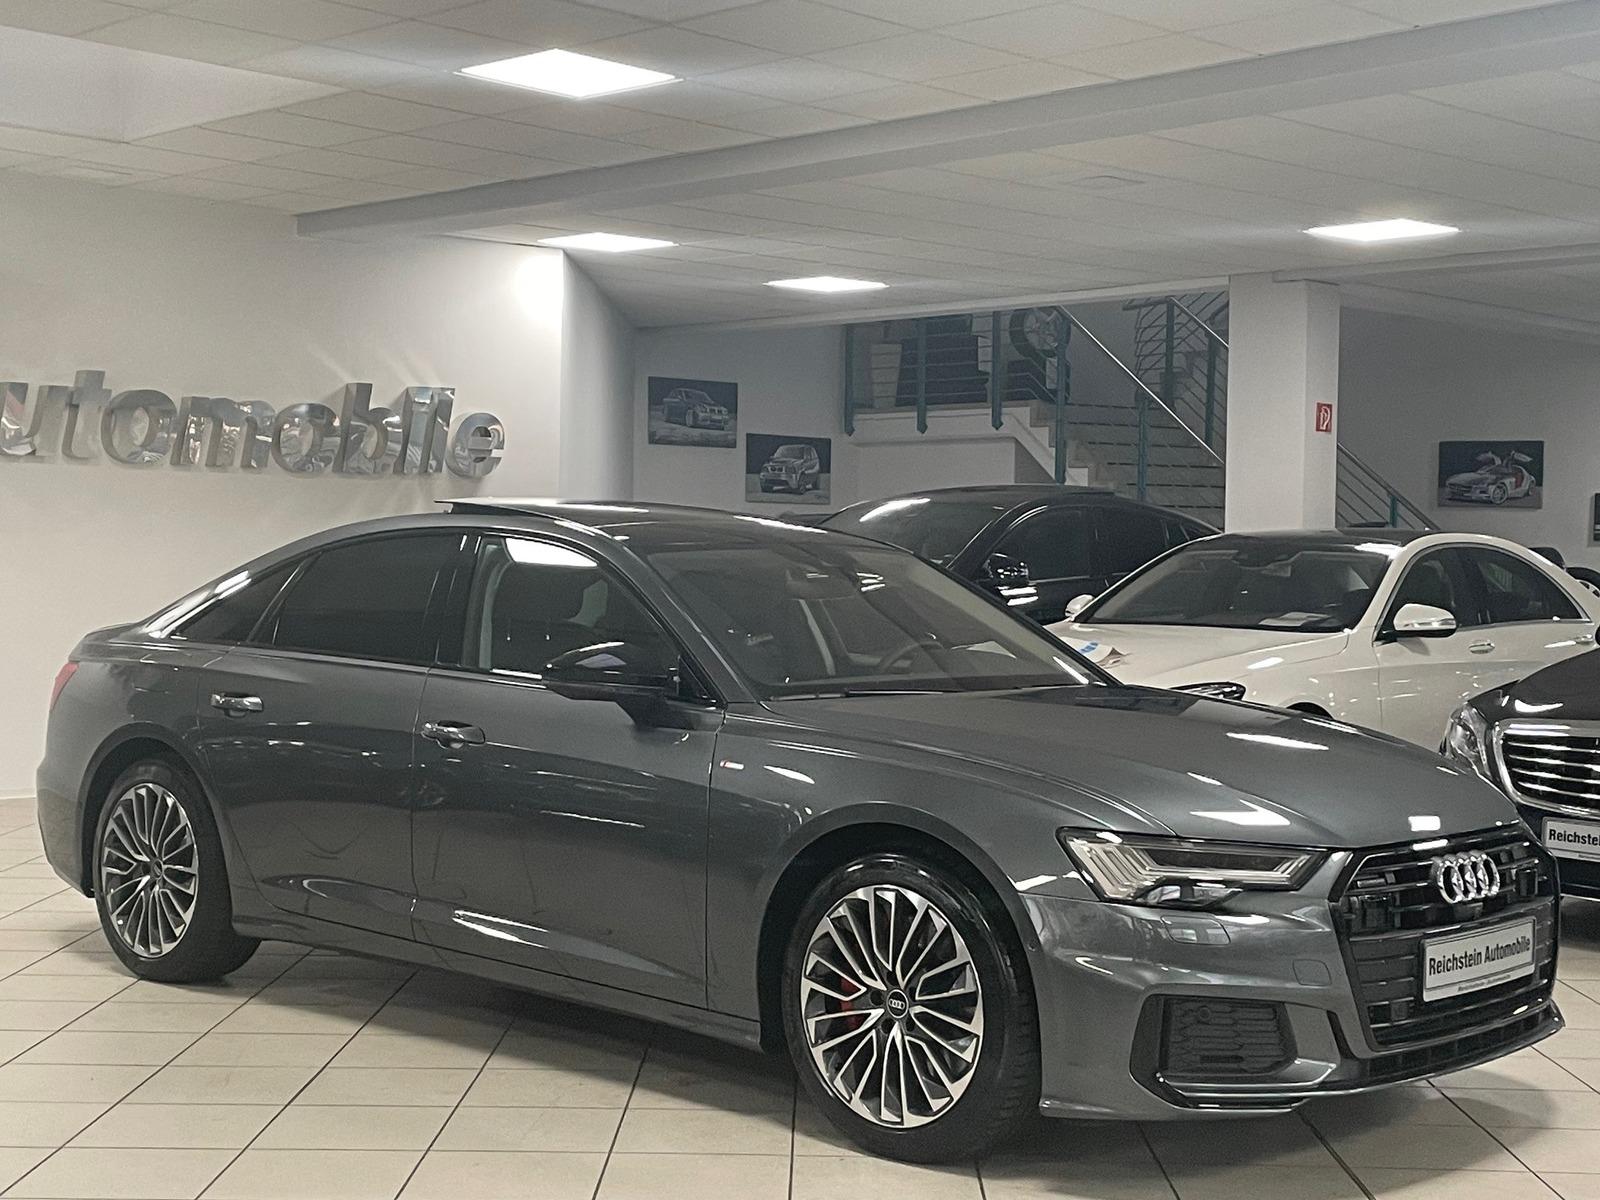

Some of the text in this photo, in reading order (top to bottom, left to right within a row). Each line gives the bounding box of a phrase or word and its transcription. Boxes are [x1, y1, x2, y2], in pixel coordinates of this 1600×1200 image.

[1548, 829, 1600, 846] Reichste
[1428, 936, 1531, 976] Reichstein Automobile
